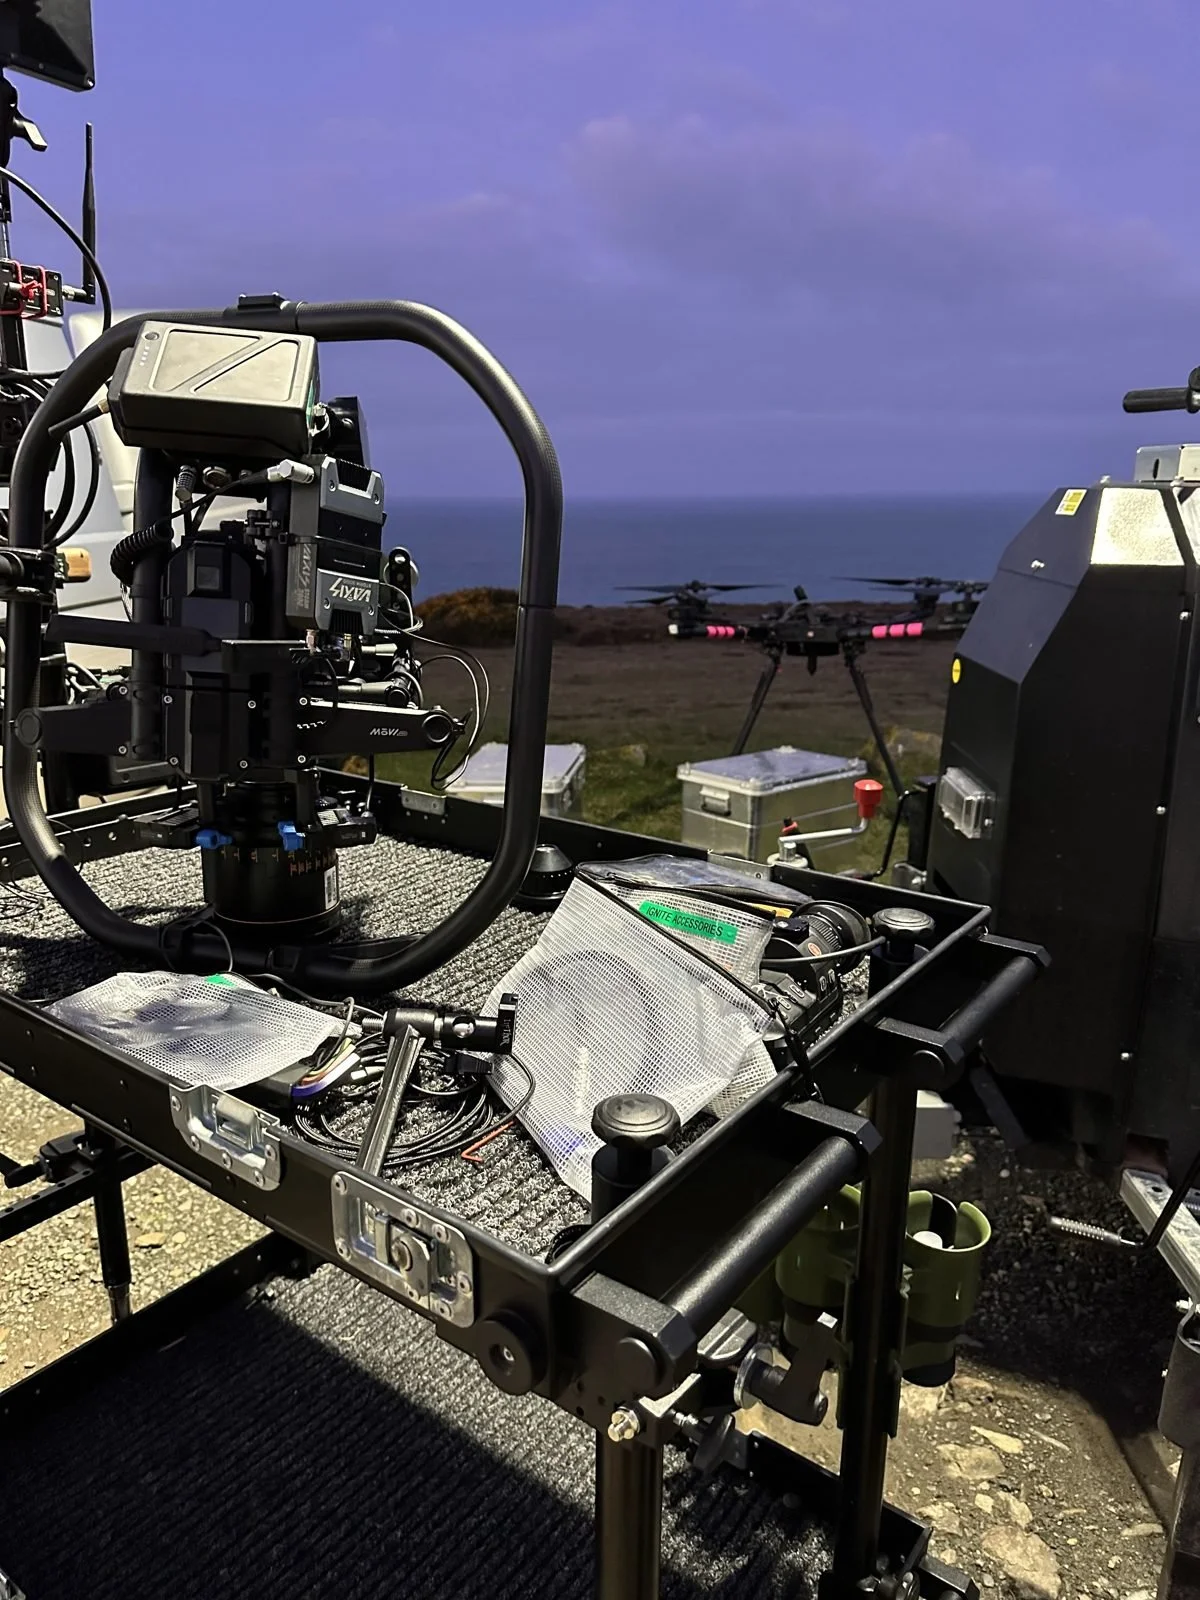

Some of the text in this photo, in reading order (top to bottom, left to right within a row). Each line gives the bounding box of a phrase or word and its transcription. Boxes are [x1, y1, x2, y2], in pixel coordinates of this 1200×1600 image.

[298, 543, 311, 587] VAXIS
[329, 577, 372, 602] VAXIS
[646, 906, 724, 937] IGNITE ACCESSORIES
